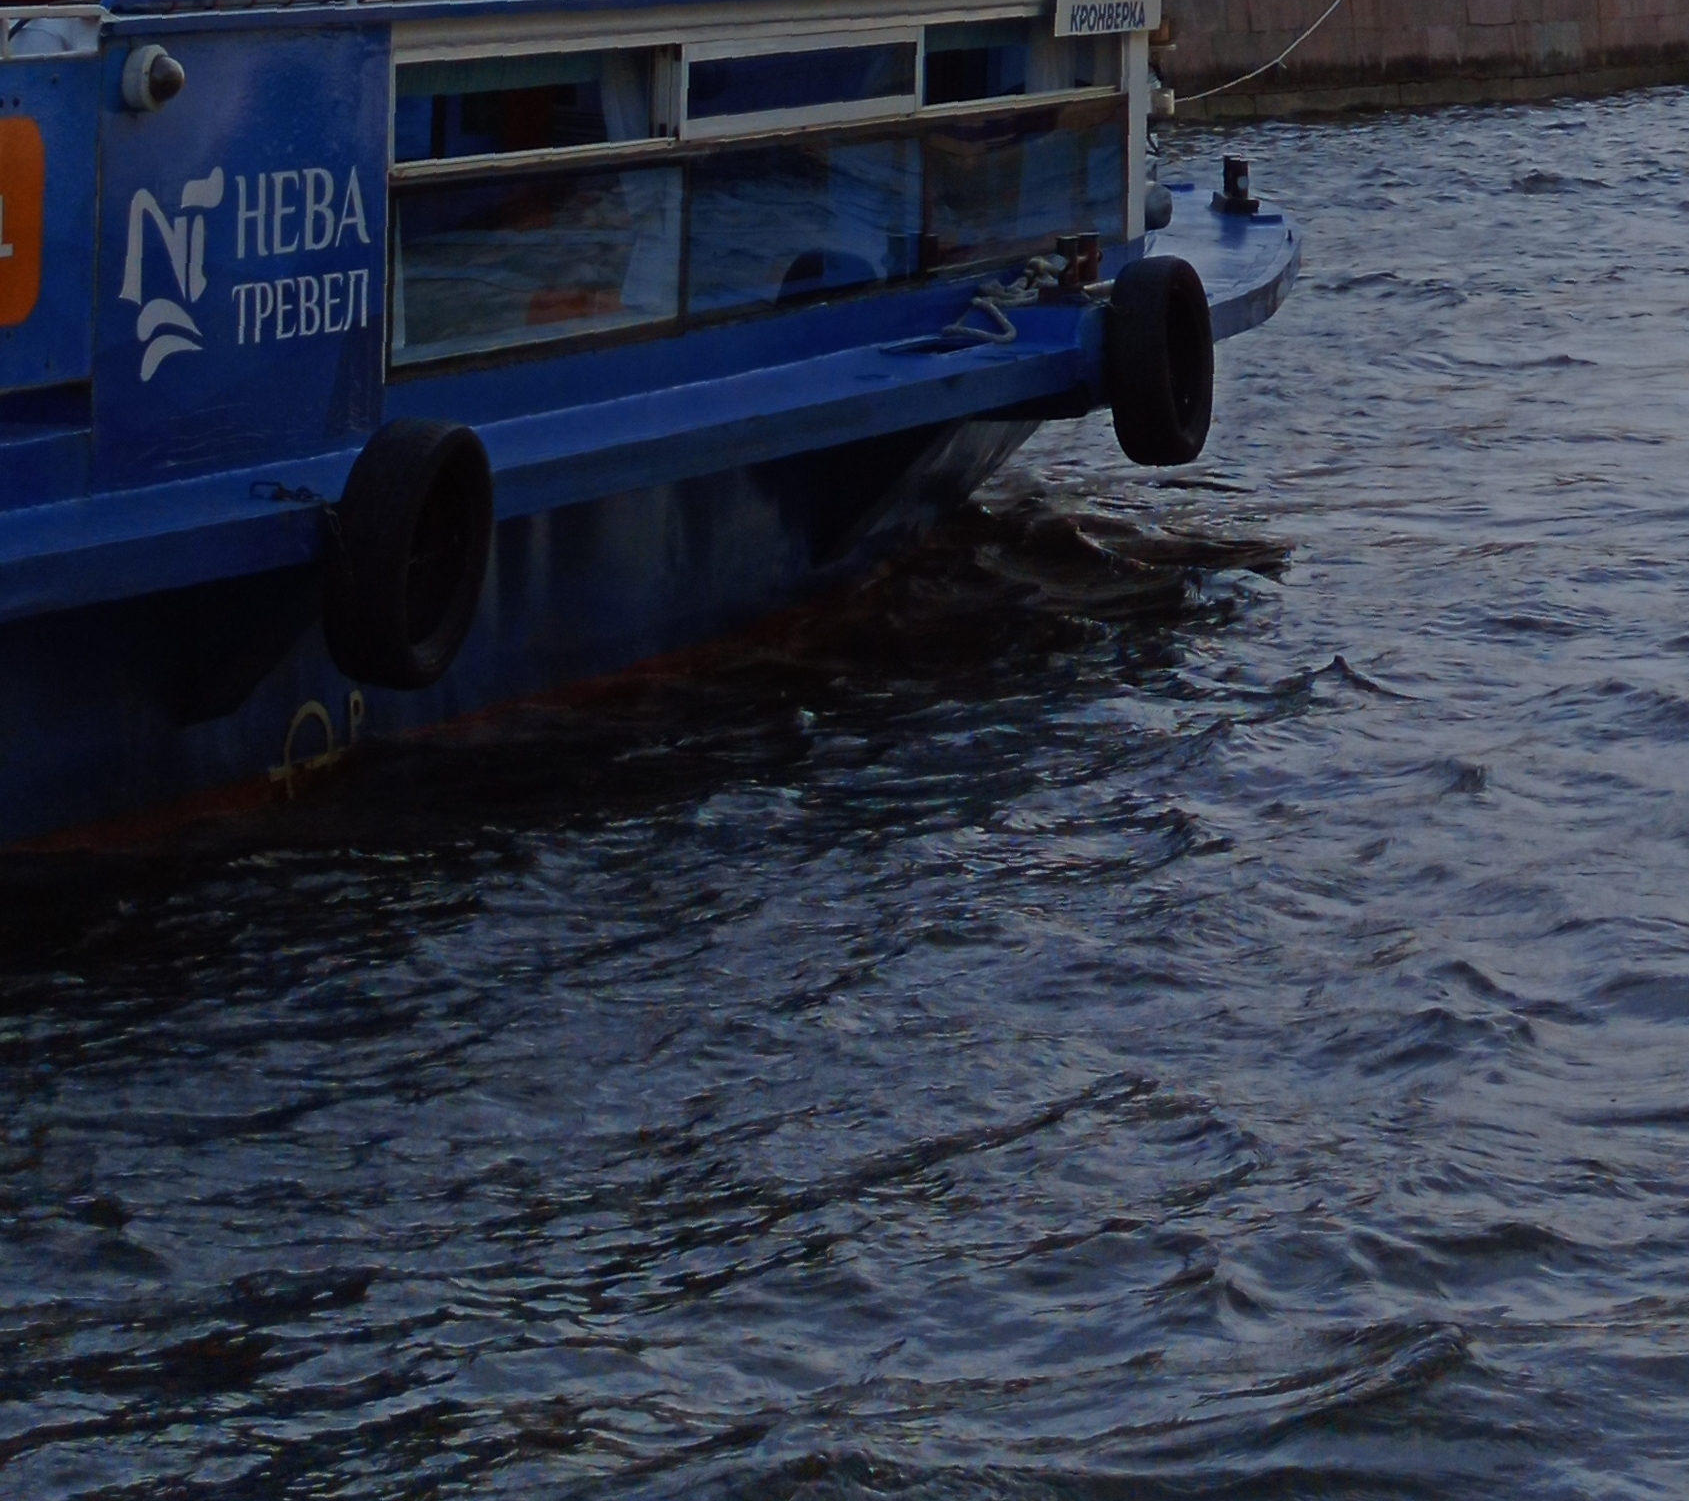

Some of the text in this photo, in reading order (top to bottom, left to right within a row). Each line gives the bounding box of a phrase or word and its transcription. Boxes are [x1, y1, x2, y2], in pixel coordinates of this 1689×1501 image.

[1071, 2, 1145, 32] КРОНВЕРКА
[235, 166, 371, 260] НЕВА
[232, 268, 369, 345] ТРЕВЕЛ
